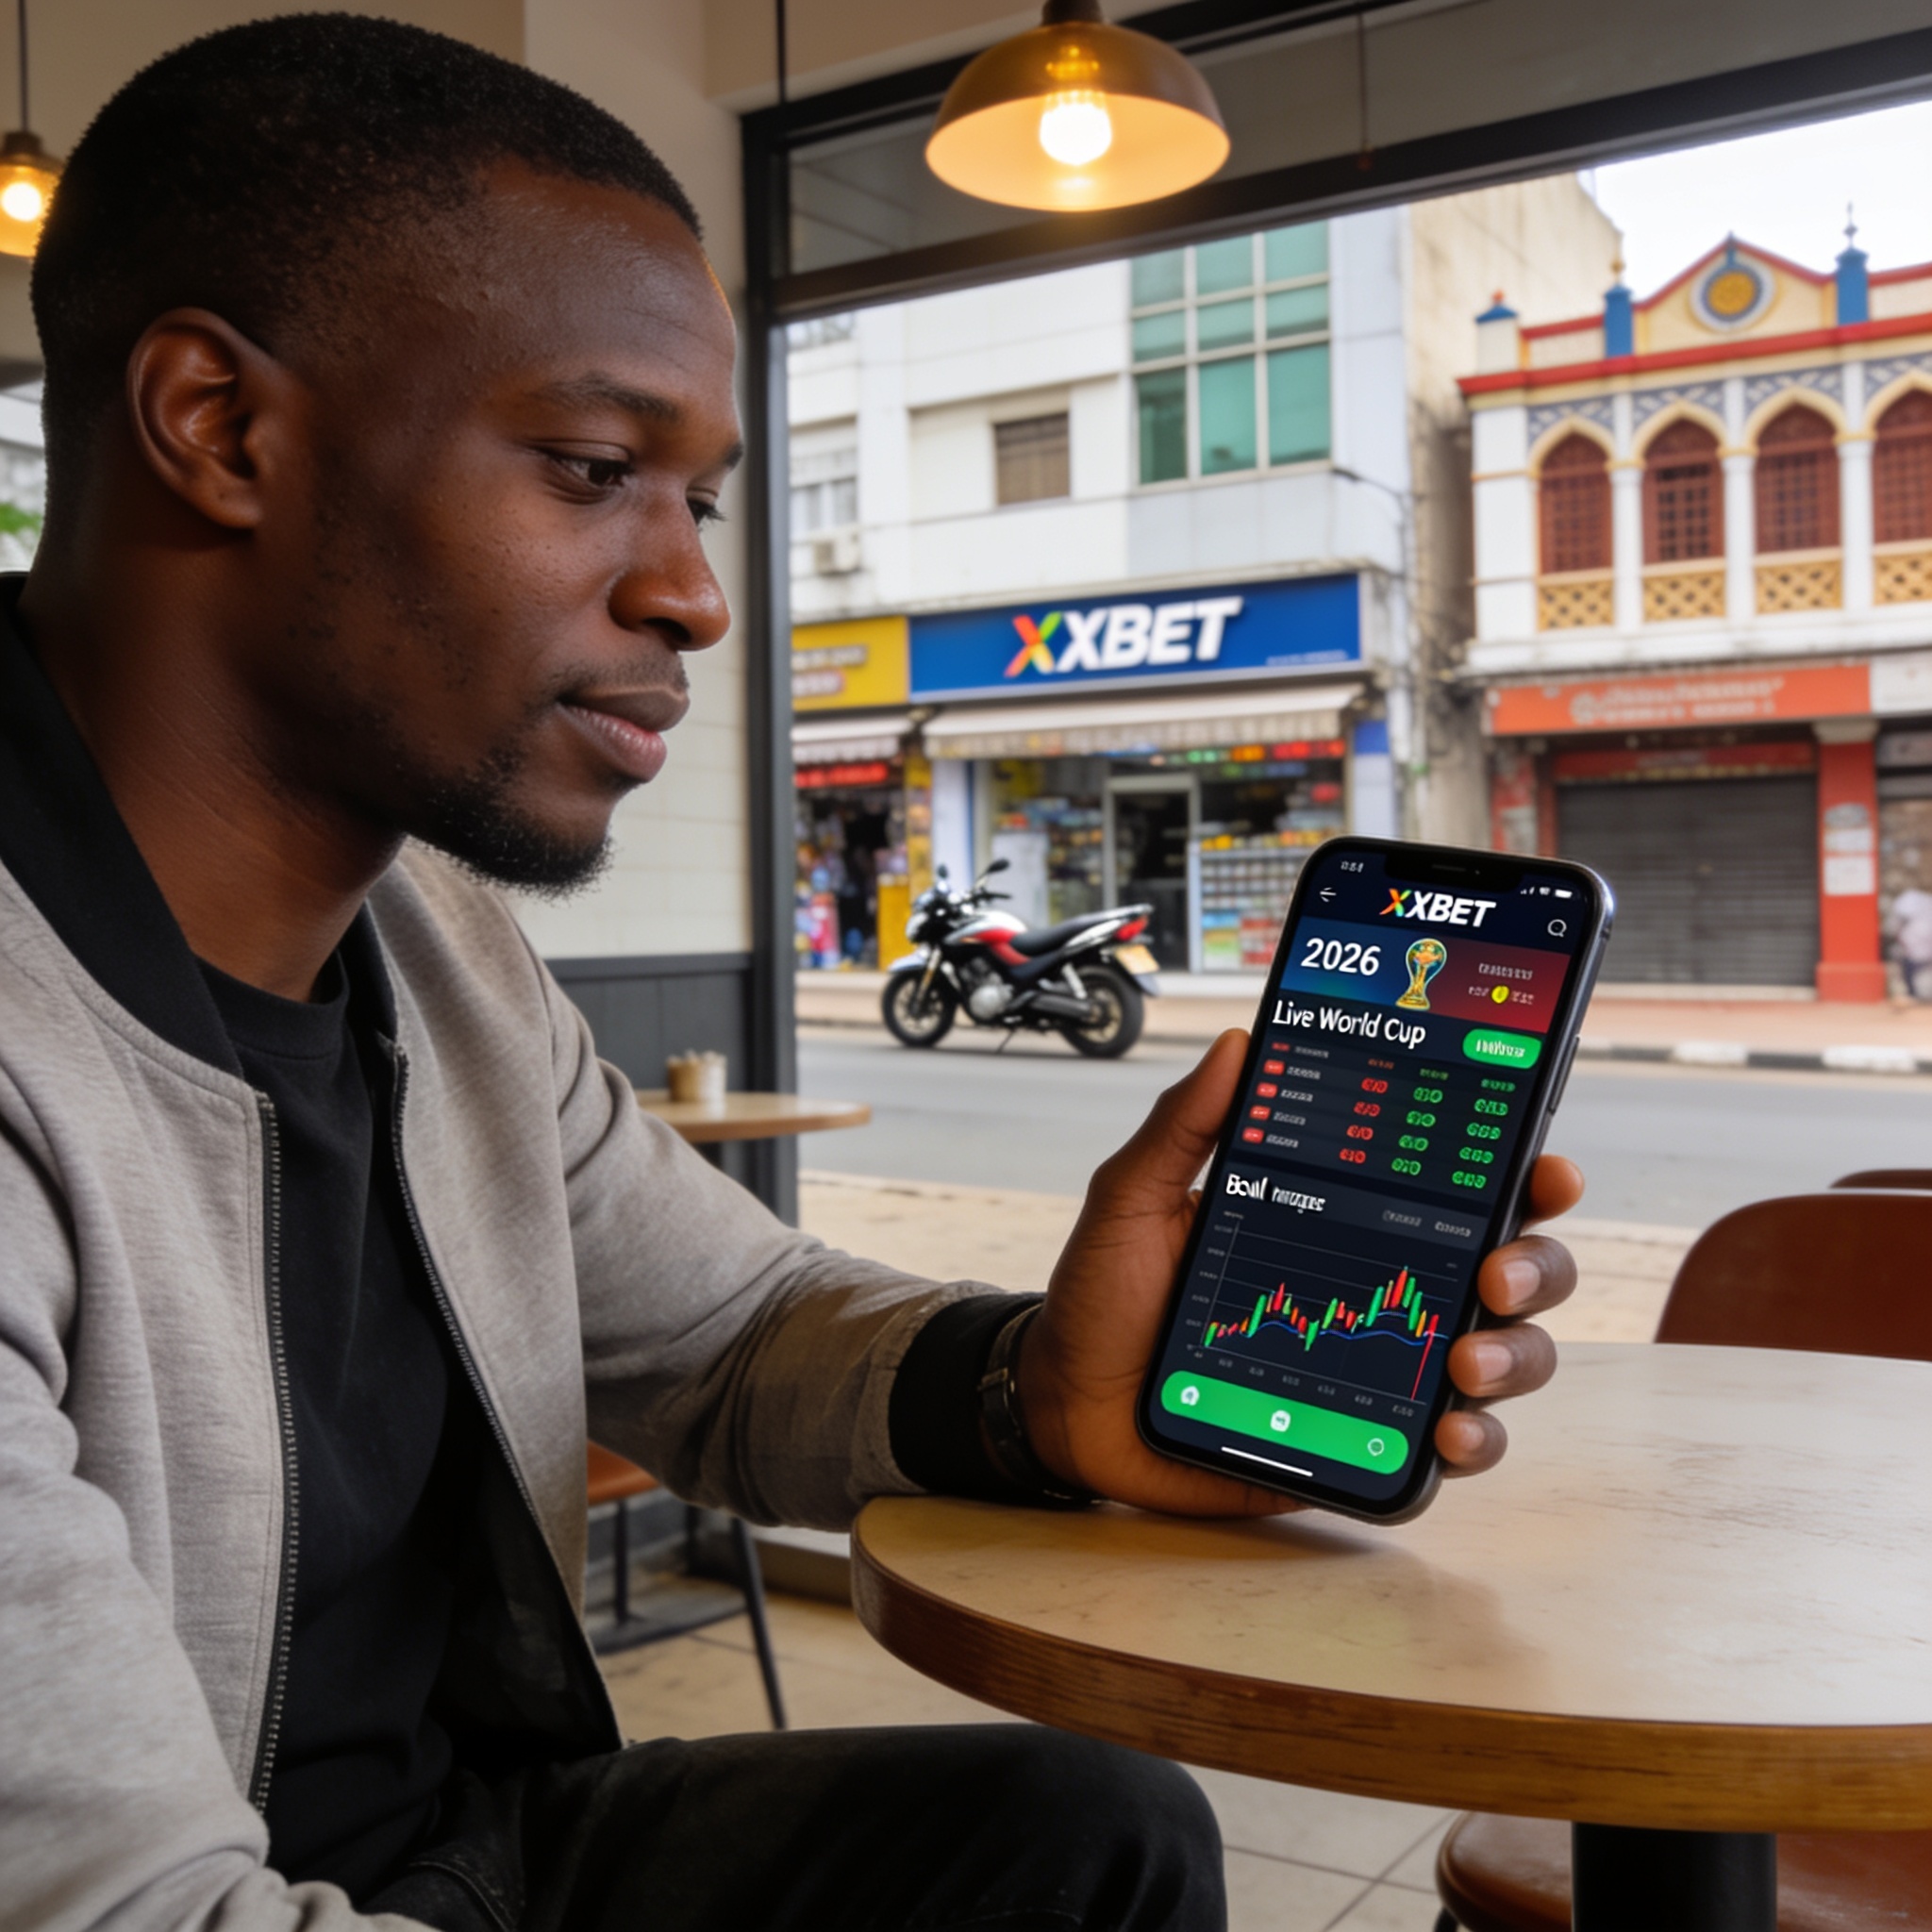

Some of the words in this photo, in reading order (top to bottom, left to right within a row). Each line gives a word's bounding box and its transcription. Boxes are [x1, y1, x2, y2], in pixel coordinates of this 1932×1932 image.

[1004, 595, 1243, 677] XXBET
[1379, 888, 1497, 927] XXBET
[1300, 938, 1381, 975] 2026
[1273, 1000, 1315, 1027] Live
[1320, 1007, 1382, 1038] World
[1384, 1018, 1426, 1049] Cup
